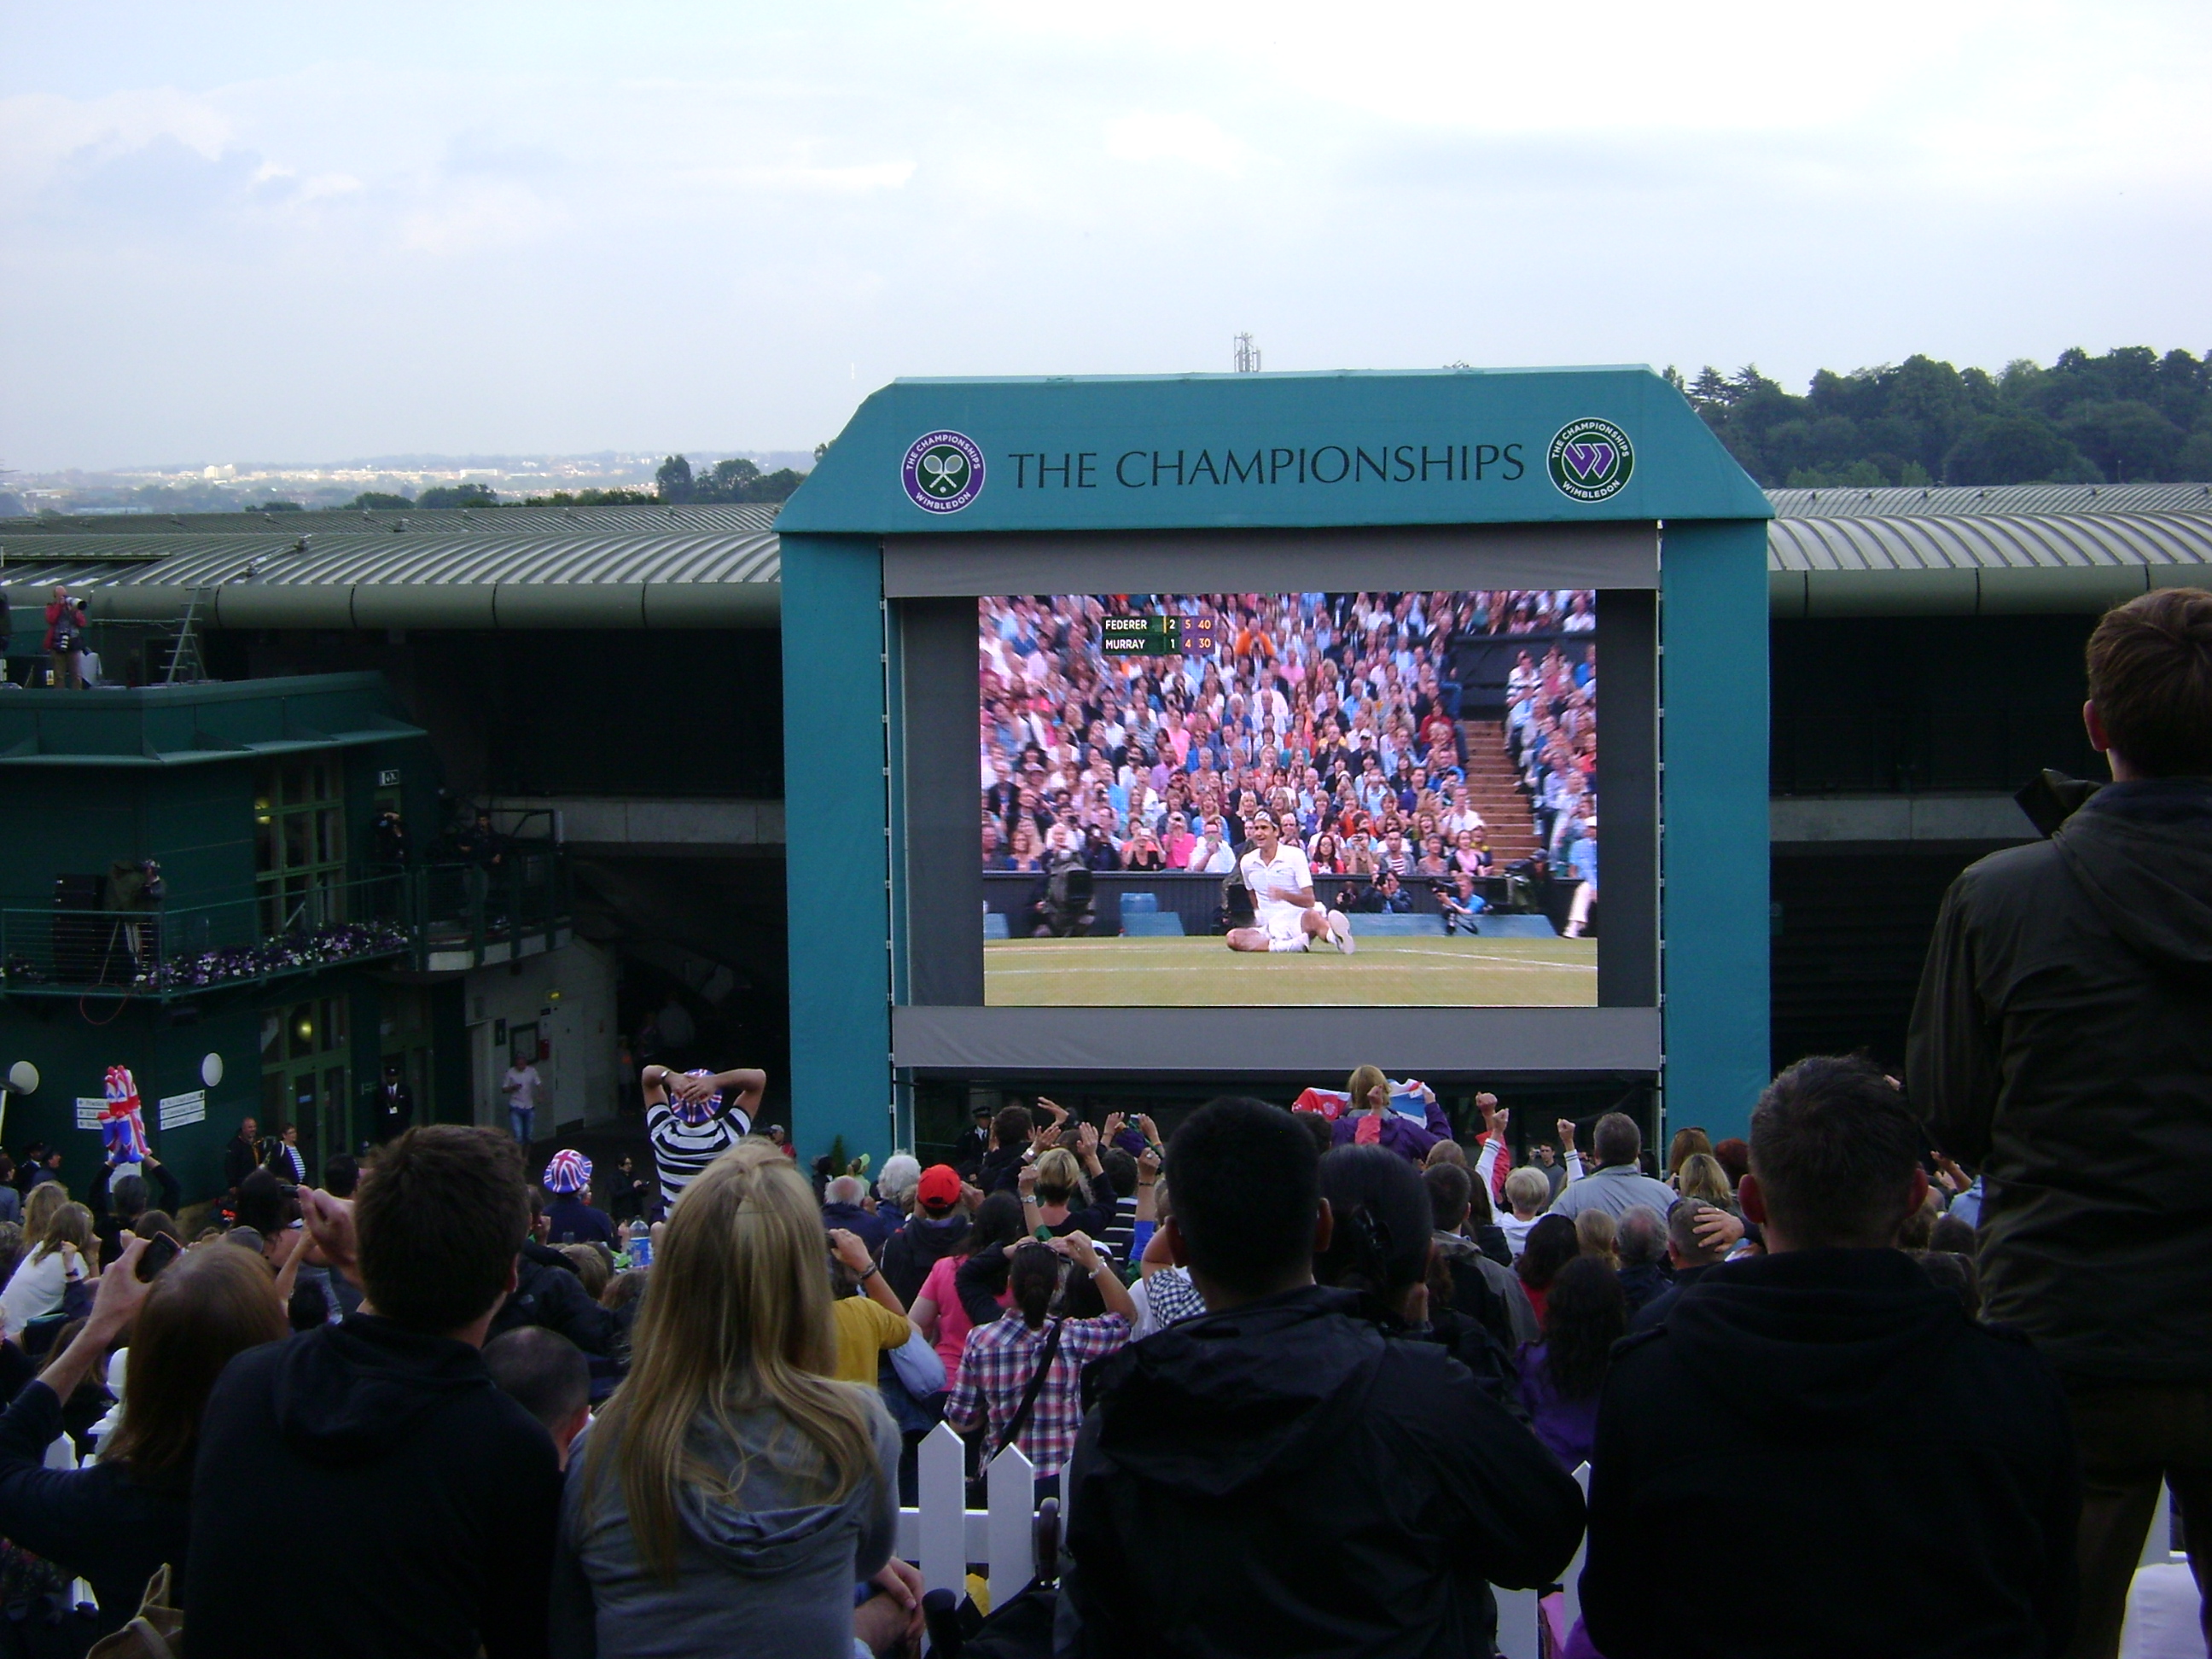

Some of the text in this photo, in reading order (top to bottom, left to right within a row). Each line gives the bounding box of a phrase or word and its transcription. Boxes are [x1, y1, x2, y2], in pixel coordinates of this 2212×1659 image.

[1551, 422, 1629, 458] THE CHAMPIONSHIPS
[906, 434, 981, 469] THE CHAMPIONSHIPS
[1008, 443, 1524, 489] THE CHAMPIONSHIPS
[1563, 480, 1621, 498] WIMBLEDON
[916, 492, 971, 509] WIMBLEDON
[1105, 619, 1212, 630] FEDERER 2 5 40
[1105, 637, 1212, 649] MURRAY 1 4 30
